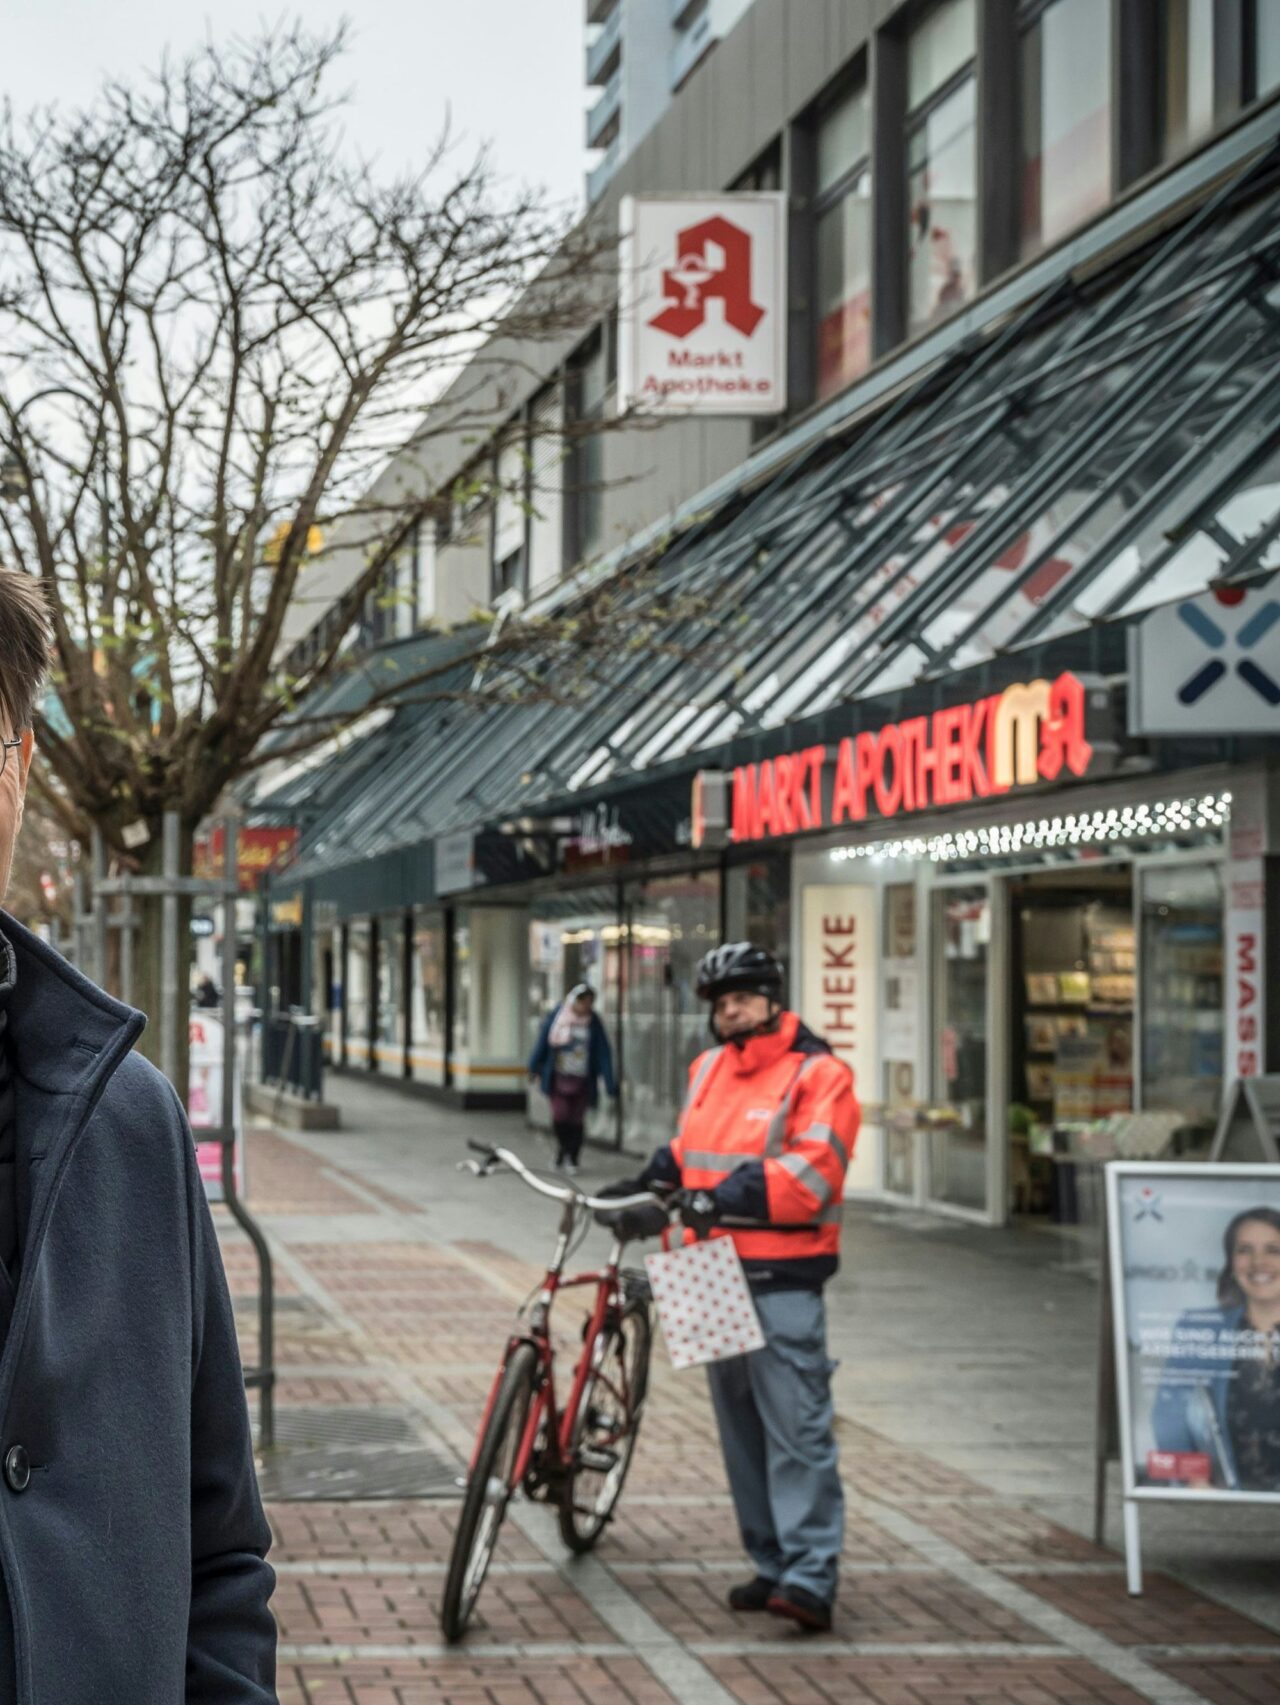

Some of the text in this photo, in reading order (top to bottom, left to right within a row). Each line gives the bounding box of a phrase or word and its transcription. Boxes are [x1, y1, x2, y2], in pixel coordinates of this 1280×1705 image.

[668, 351, 744, 367] Markt
[644, 375, 771, 397] Apotheke
[732, 745, 825, 842] MARKT
